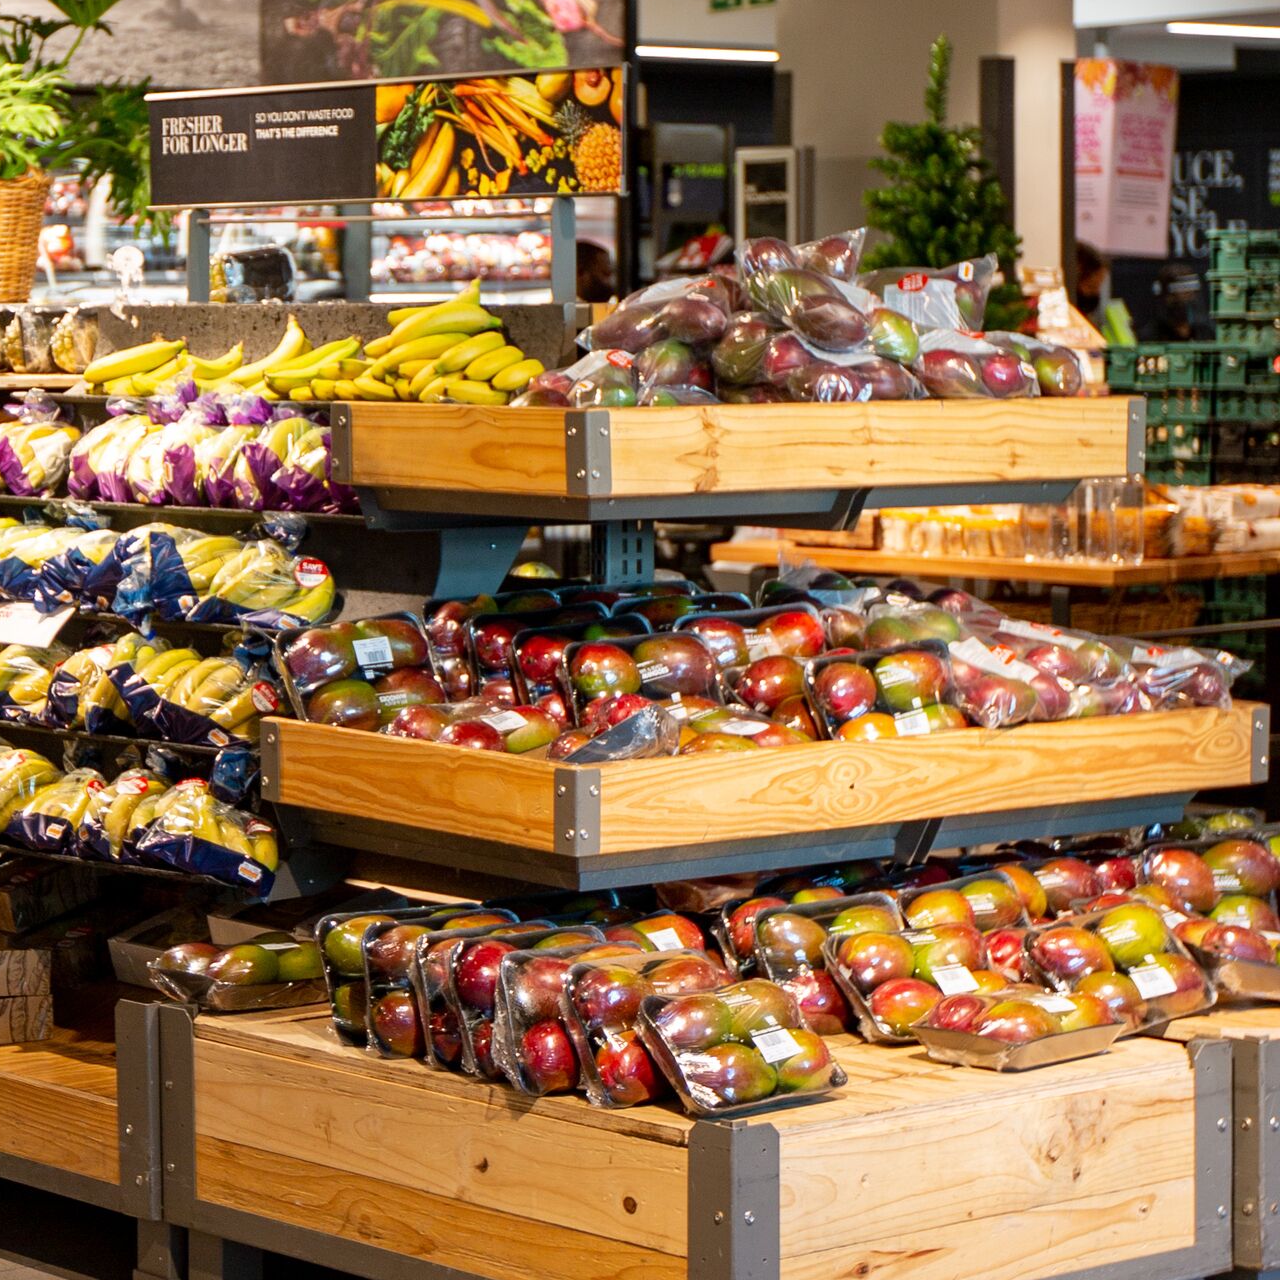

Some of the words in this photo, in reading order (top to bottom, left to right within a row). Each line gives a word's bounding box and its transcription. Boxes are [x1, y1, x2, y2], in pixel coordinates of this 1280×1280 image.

[255, 112, 266, 123] SO
[267, 111, 282, 123] YOU
[306, 108, 332, 121] WASTE
[332, 107, 354, 119] FOOD
[161, 115, 223, 136] FRESHER
[282, 126, 296, 138] THE
[296, 125, 339, 138] DIFFERENCE
[162, 135, 190, 155] FOR
[192, 132, 248, 153] LONGER
